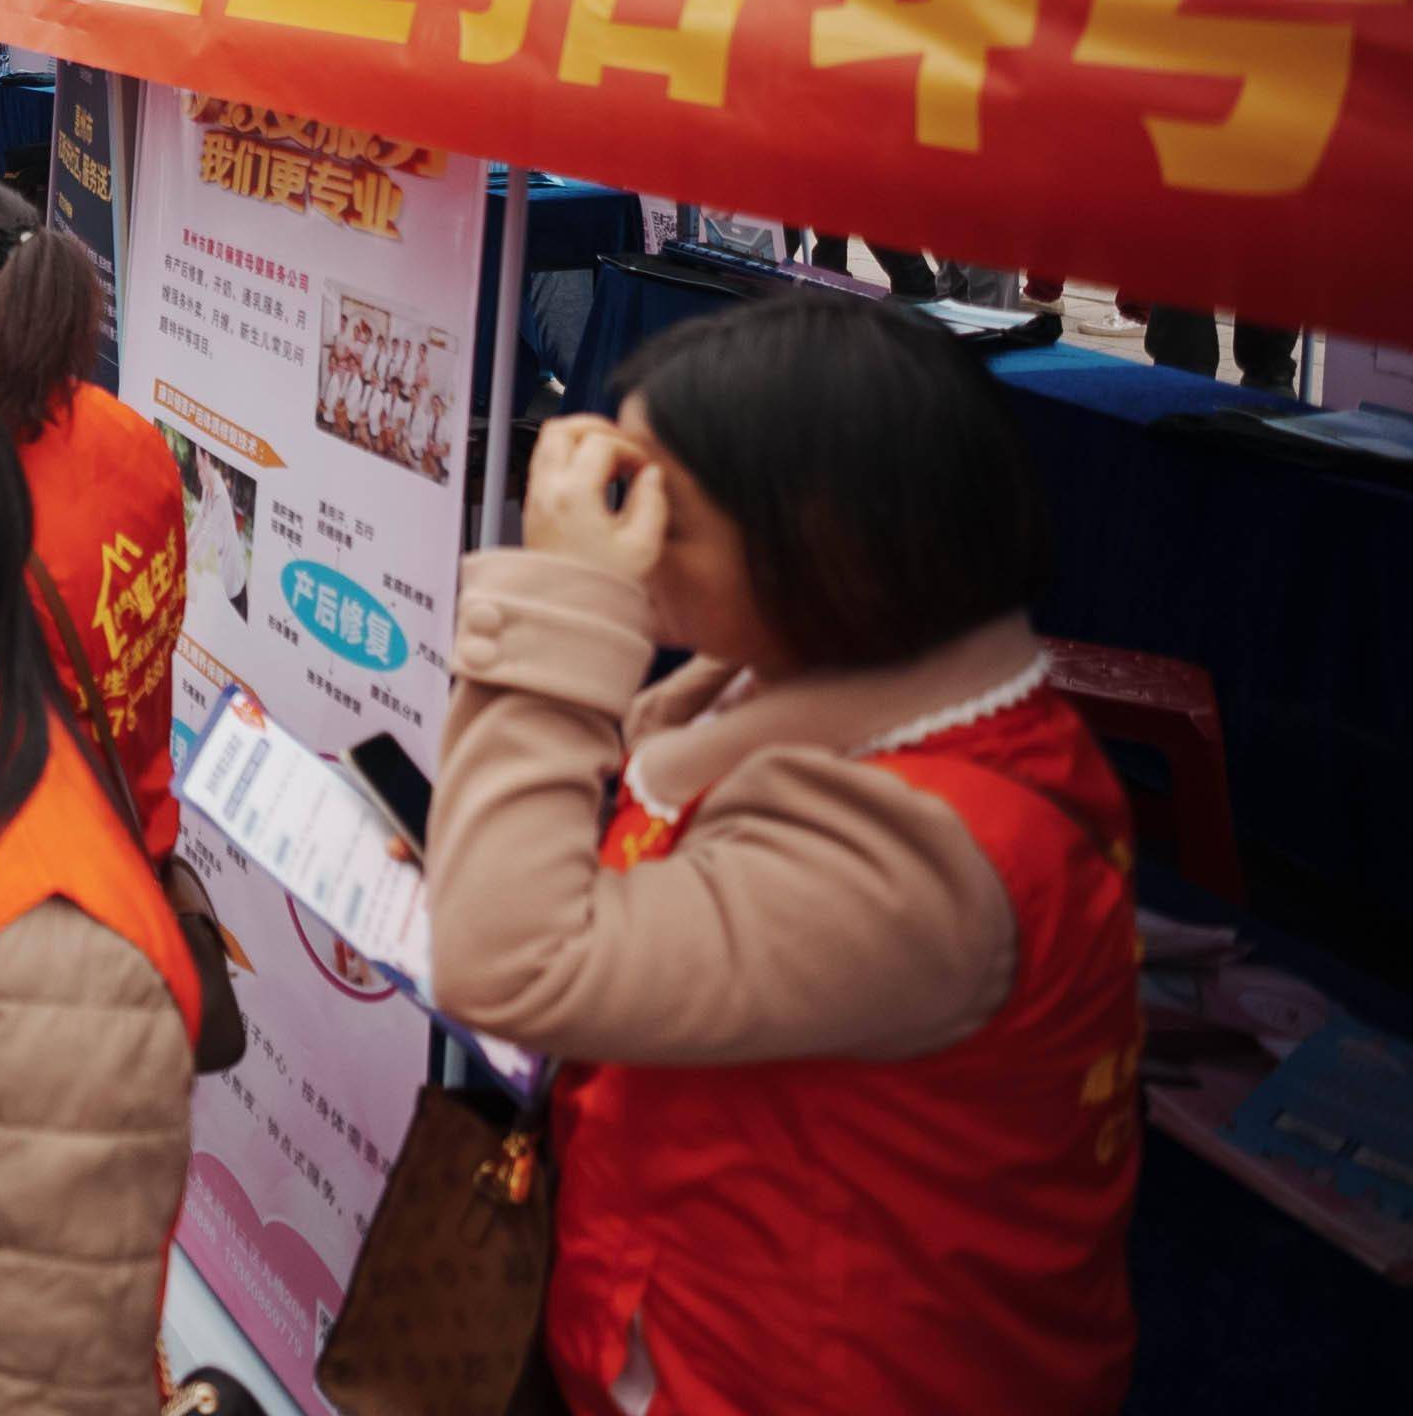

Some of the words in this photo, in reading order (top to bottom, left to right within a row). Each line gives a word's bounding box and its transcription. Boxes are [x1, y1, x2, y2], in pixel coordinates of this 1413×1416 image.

[199, 131, 407, 241] 我们更专业
[293, 569, 392, 665] 产后修复
